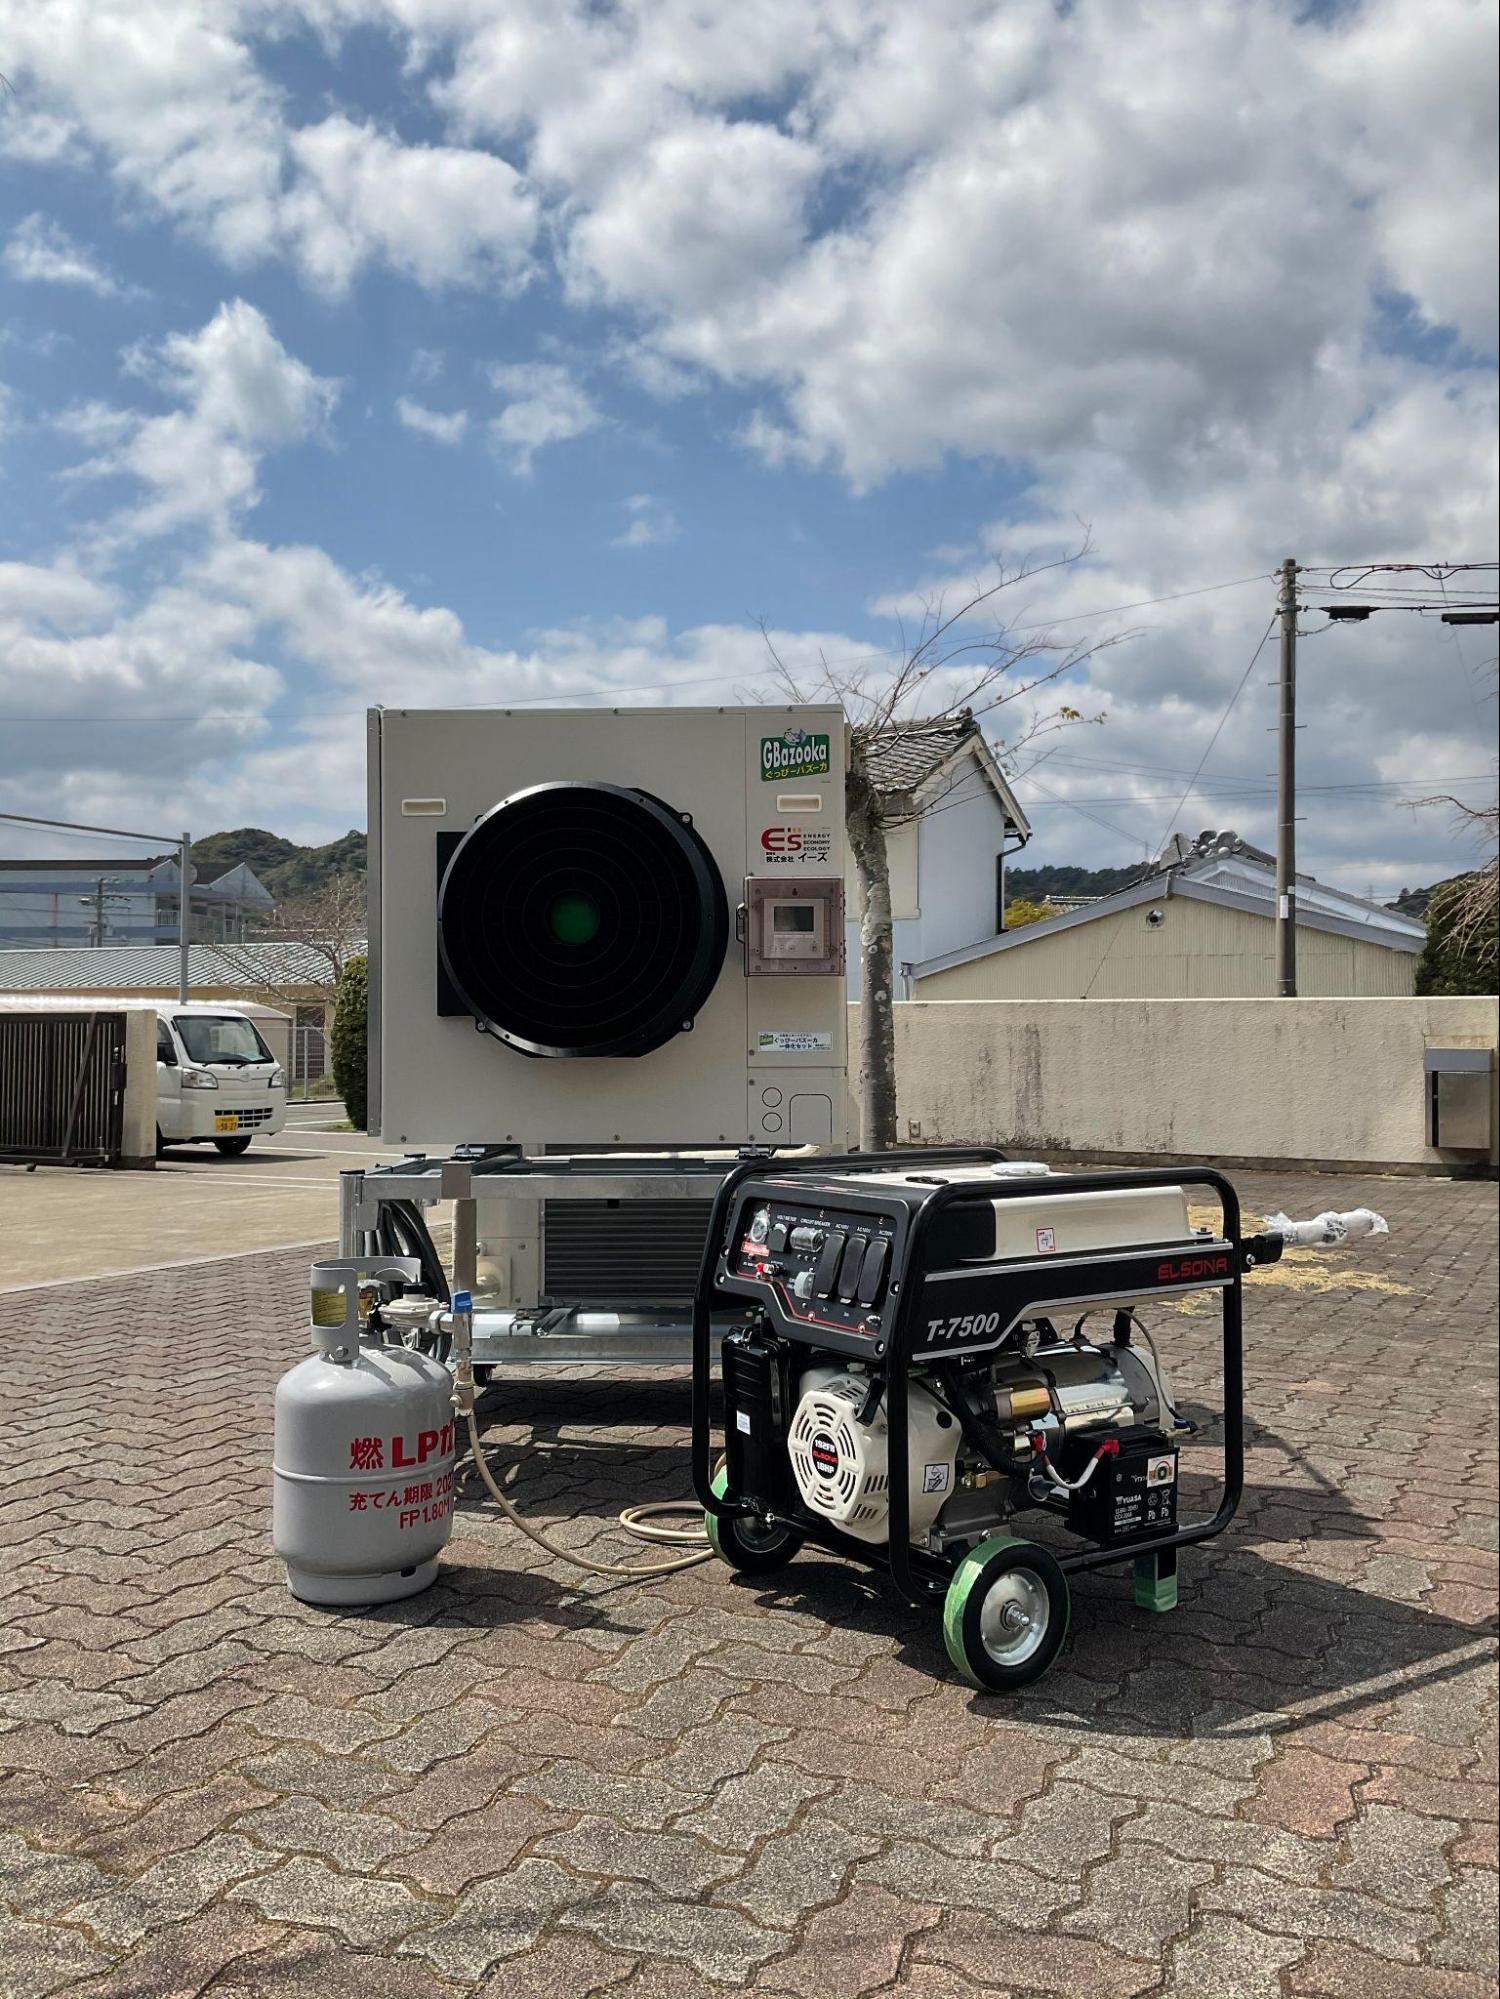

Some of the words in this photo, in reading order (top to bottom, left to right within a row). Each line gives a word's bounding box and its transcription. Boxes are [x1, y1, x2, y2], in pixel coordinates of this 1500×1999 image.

[763, 737, 827, 769] GBazooka
[765, 762, 828, 778] ぐっぴーバズーカ
[1158, 1257, 1228, 1280] ELSONA
[926, 1312, 1000, 1342] T-7500
[349, 1437, 384, 1470] 燃
[816, 1461, 835, 1474] 18HP
[349, 1482, 433, 1512] 充てん期限
[1122, 1494, 1142, 1505] YUASA
[1148, 1510, 1156, 1520] Pb
[1161, 1507, 1169, 1517] Pb
